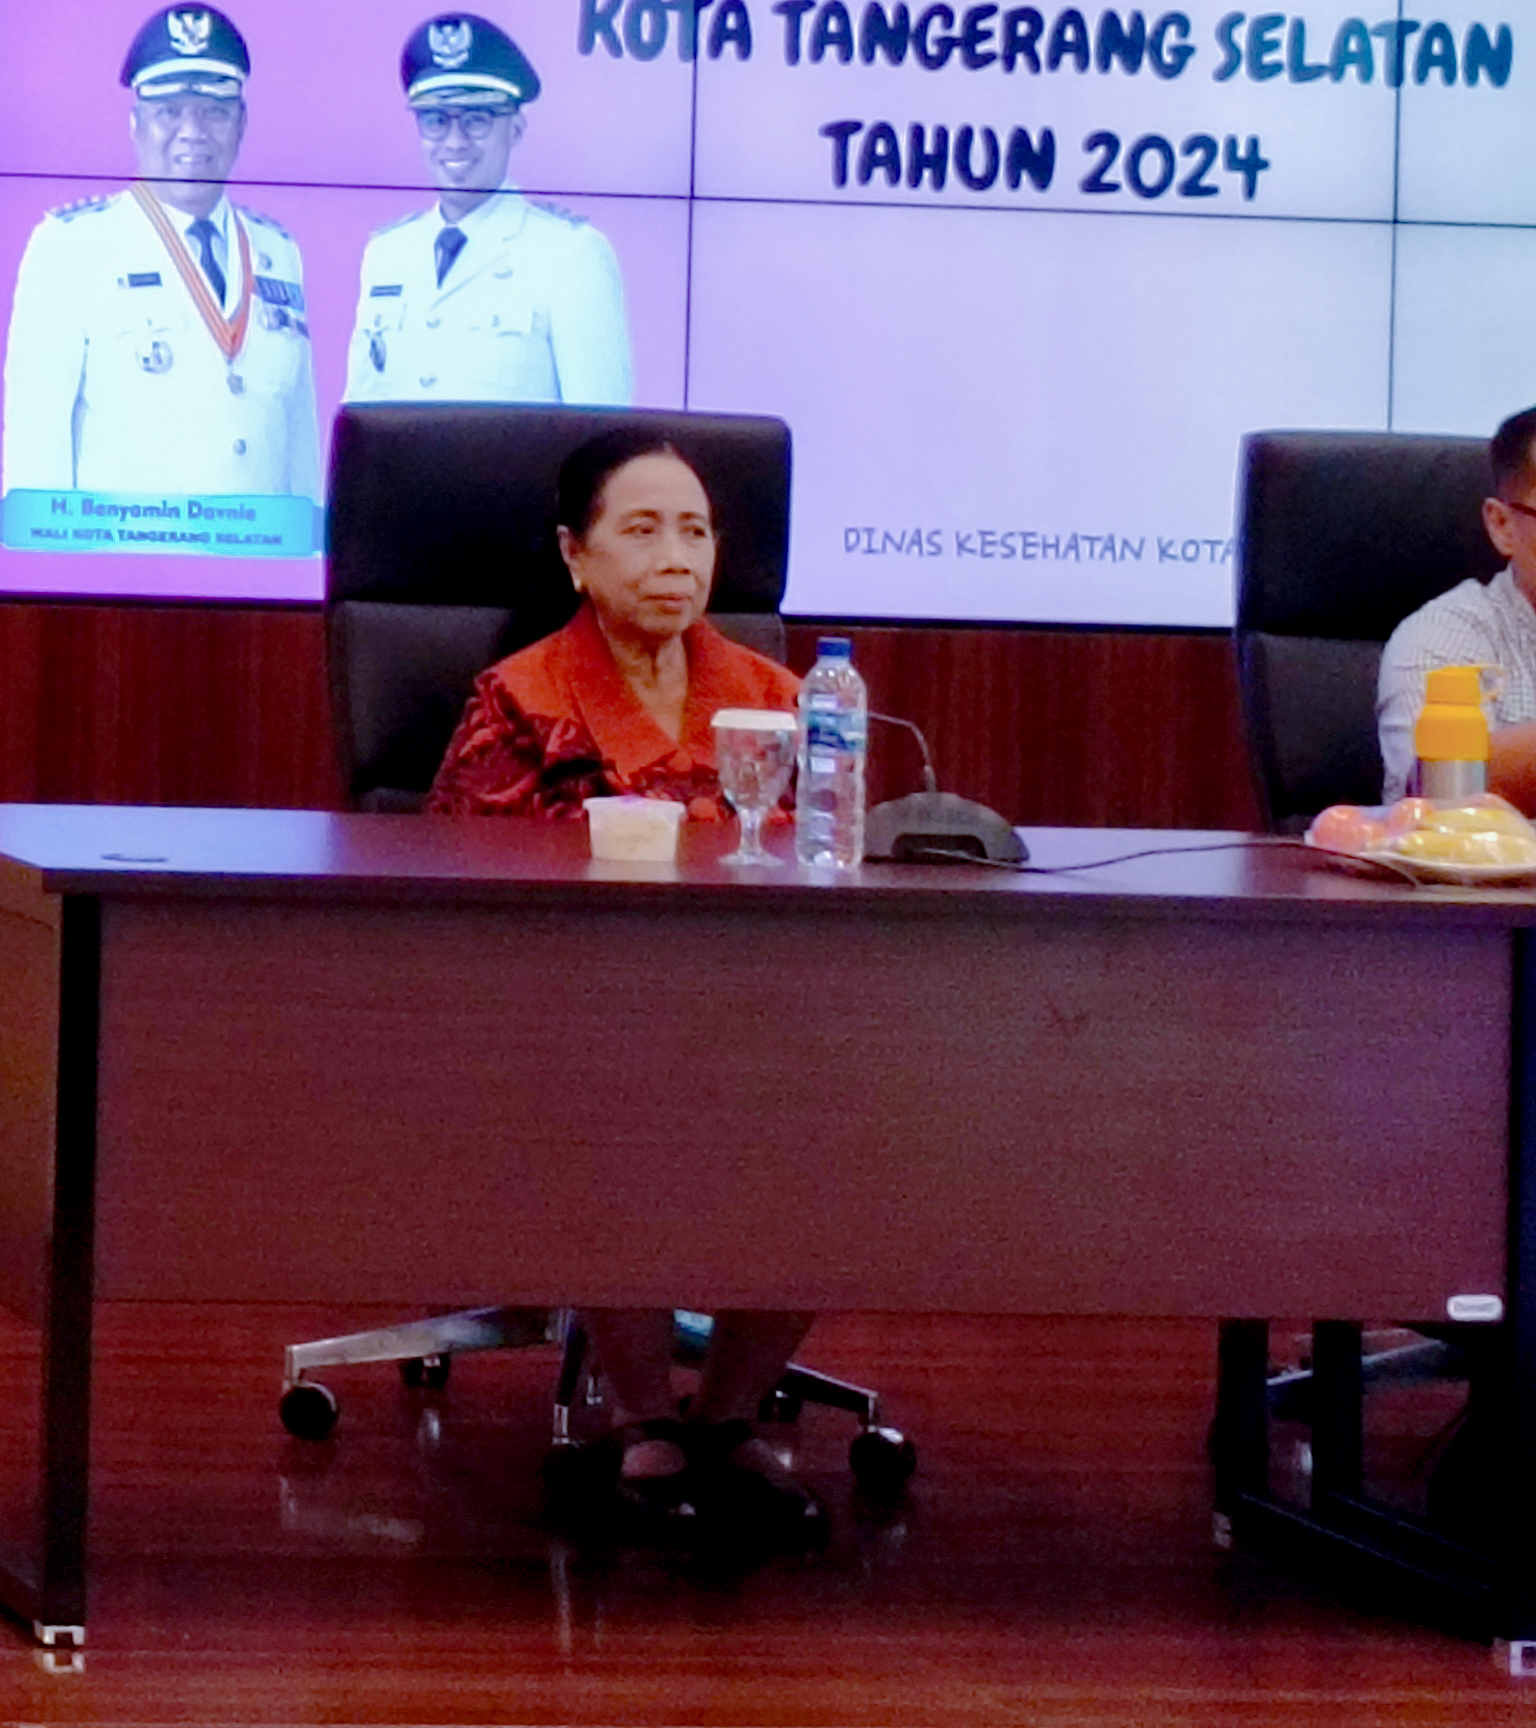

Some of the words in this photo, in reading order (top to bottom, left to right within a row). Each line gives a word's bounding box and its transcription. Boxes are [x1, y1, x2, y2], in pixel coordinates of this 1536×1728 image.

[1212, 11, 1513, 89] SELATAN
[818, 119, 1056, 192] TAHUN
[1078, 129, 1270, 202] 2024
[842, 527, 943, 558] DINAS
[954, 529, 1146, 564] KESEHATAN
